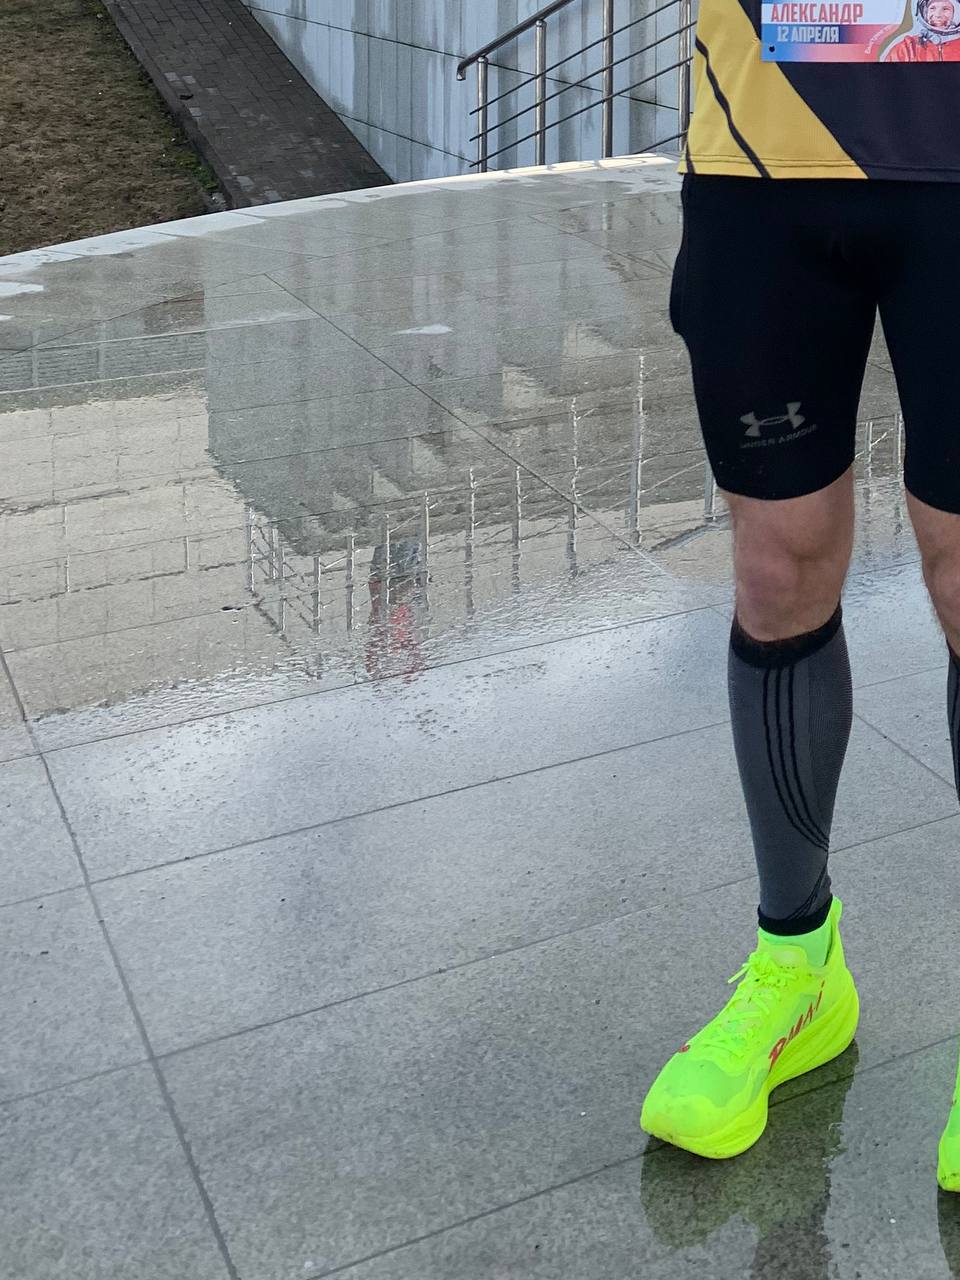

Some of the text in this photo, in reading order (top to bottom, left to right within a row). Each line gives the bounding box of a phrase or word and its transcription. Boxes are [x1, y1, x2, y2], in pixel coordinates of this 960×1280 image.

[771, 3, 863, 24] АЛЕКСАНДР
[777, 26, 839, 43] 12 АПРЕЛЯ
